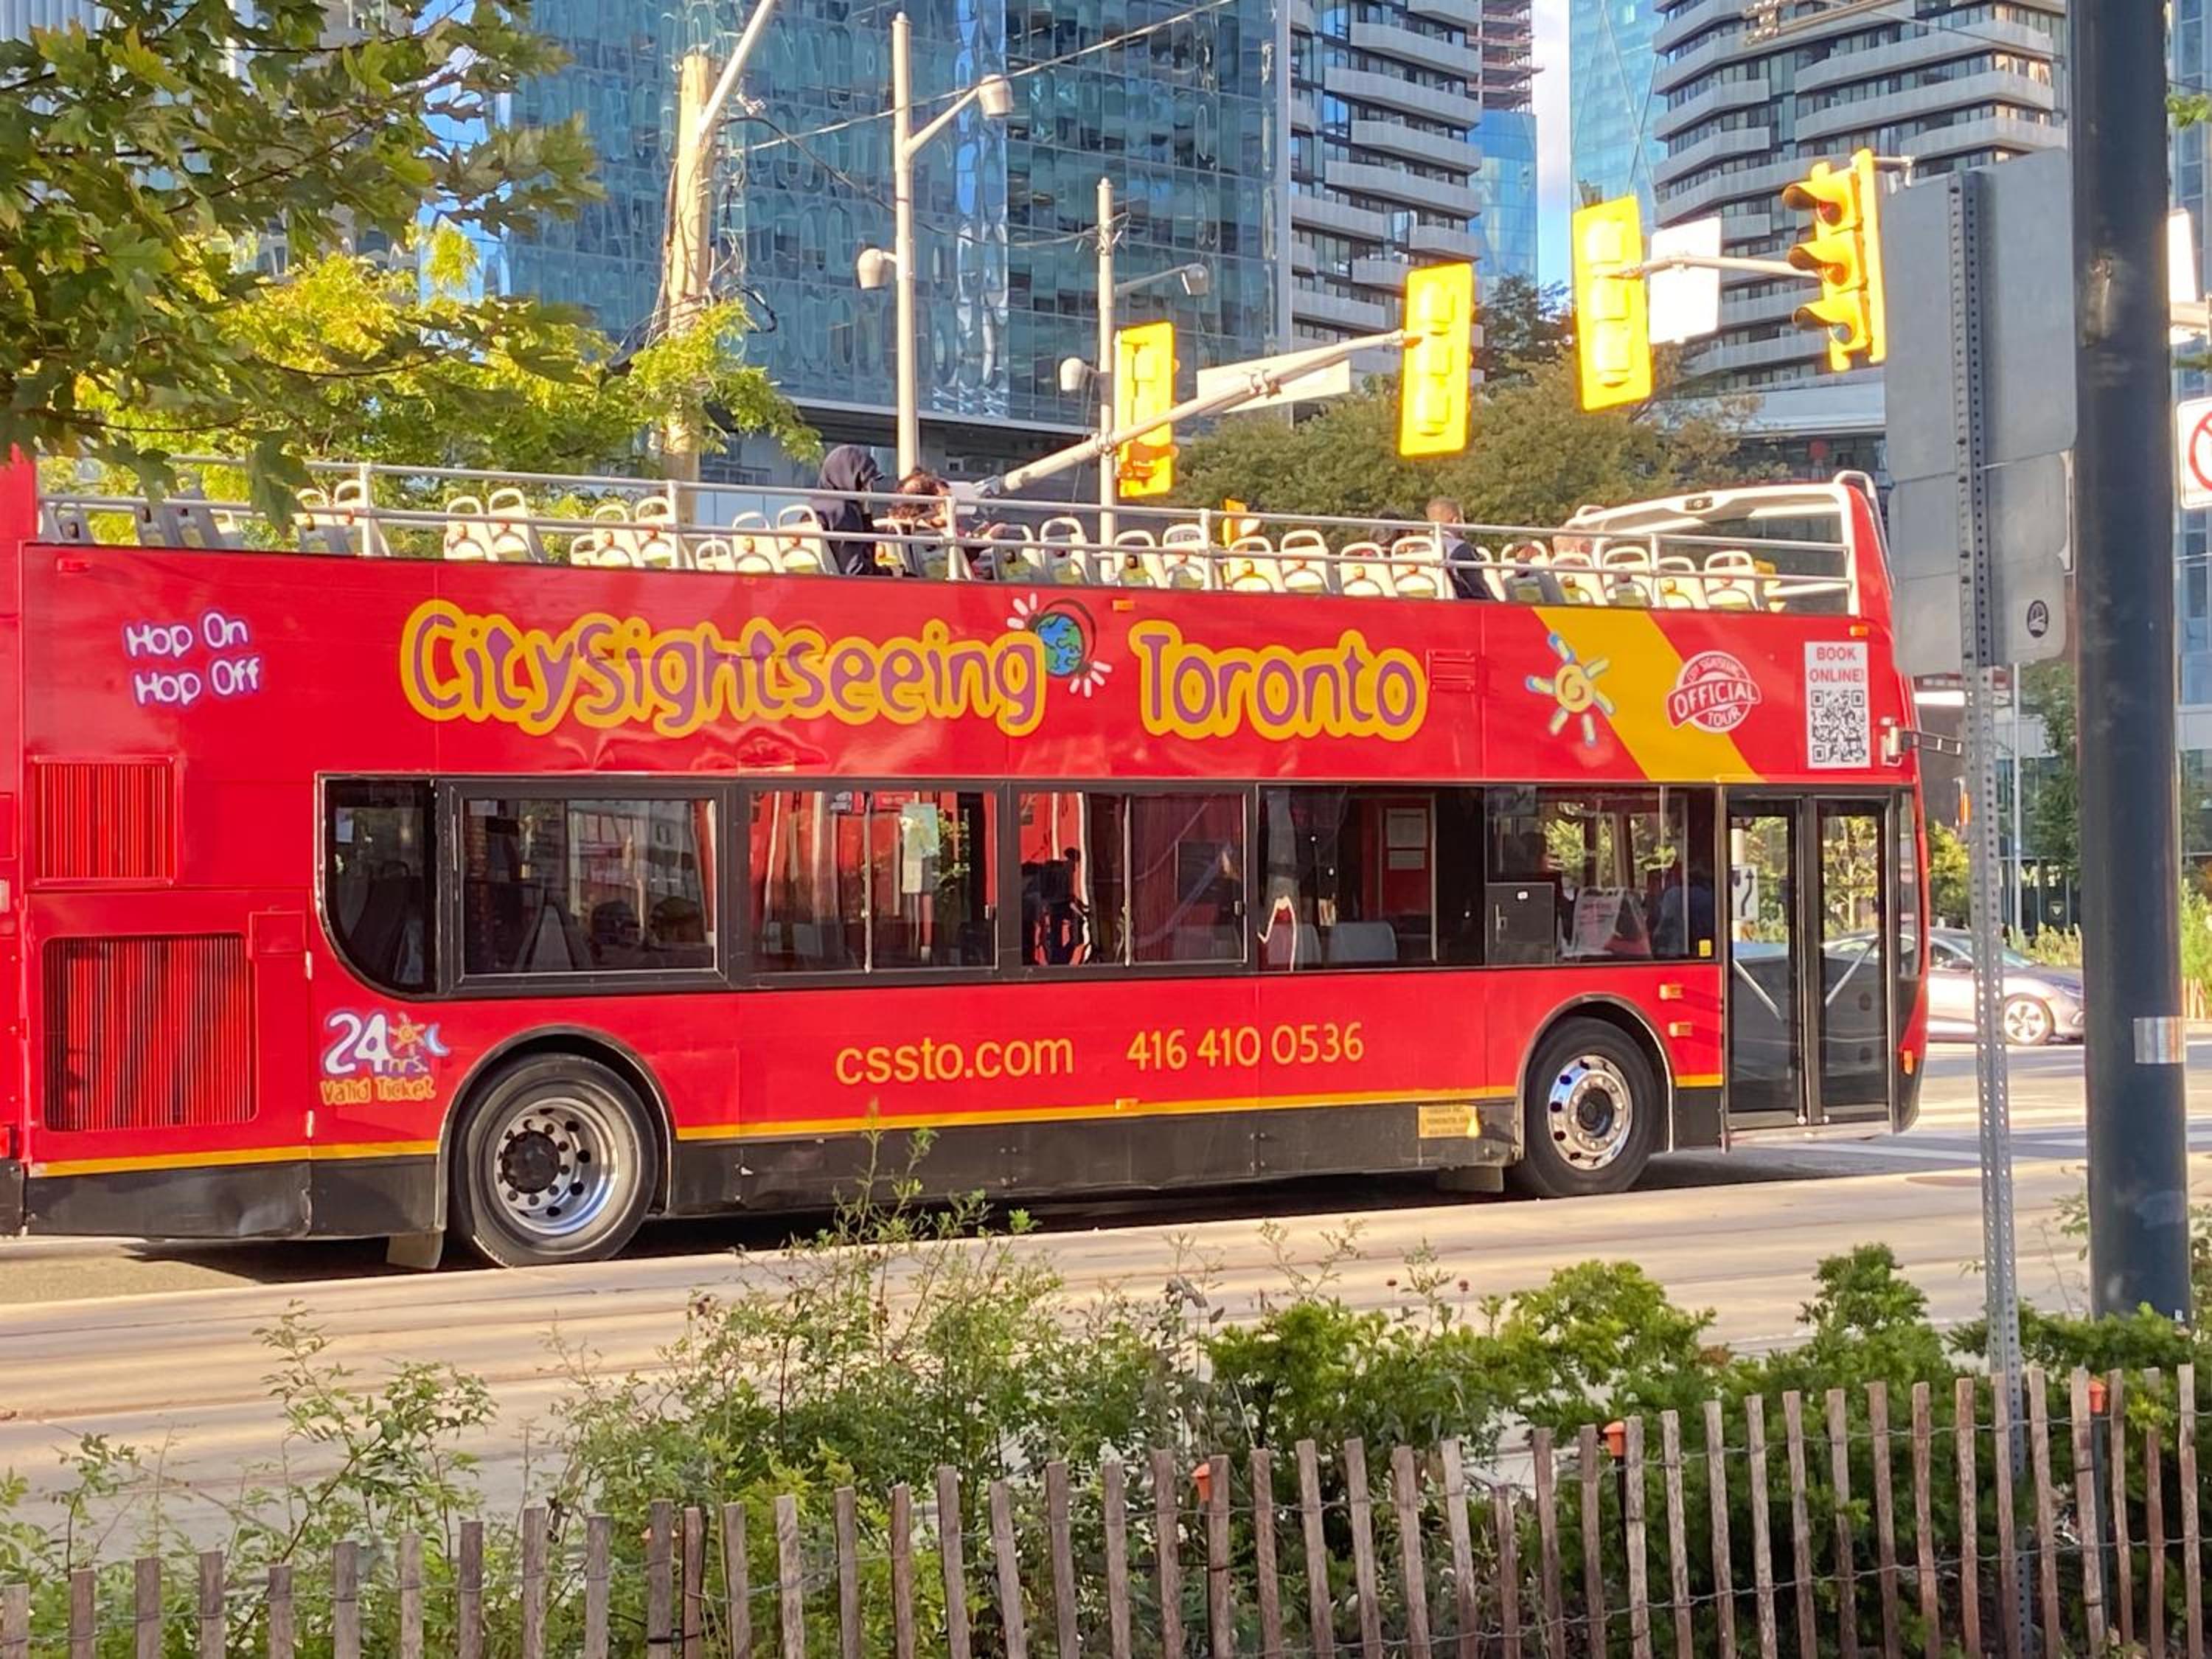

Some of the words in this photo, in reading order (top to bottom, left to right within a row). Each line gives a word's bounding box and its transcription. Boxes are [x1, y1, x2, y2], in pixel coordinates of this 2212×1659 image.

[125, 623, 195, 660] Hop
[202, 611, 249, 650] On
[1816, 647, 1858, 661] BOOK
[133, 670, 203, 706] Hop
[210, 657, 261, 696] Off
[1128, 619, 1427, 741] Toronto
[1674, 681, 1758, 720] OFFICIAL
[1707, 706, 1742, 727] TOUR
[324, 1012, 392, 1075] 24
[835, 1037, 1074, 1085] cssto.com
[1127, 1029, 1189, 1071] 416
[1197, 1025, 1262, 1068] 410
[1270, 1020, 1364, 1065] 0536
[320, 1078, 372, 1106] Valid
[375, 1074, 437, 1102] Ticket
